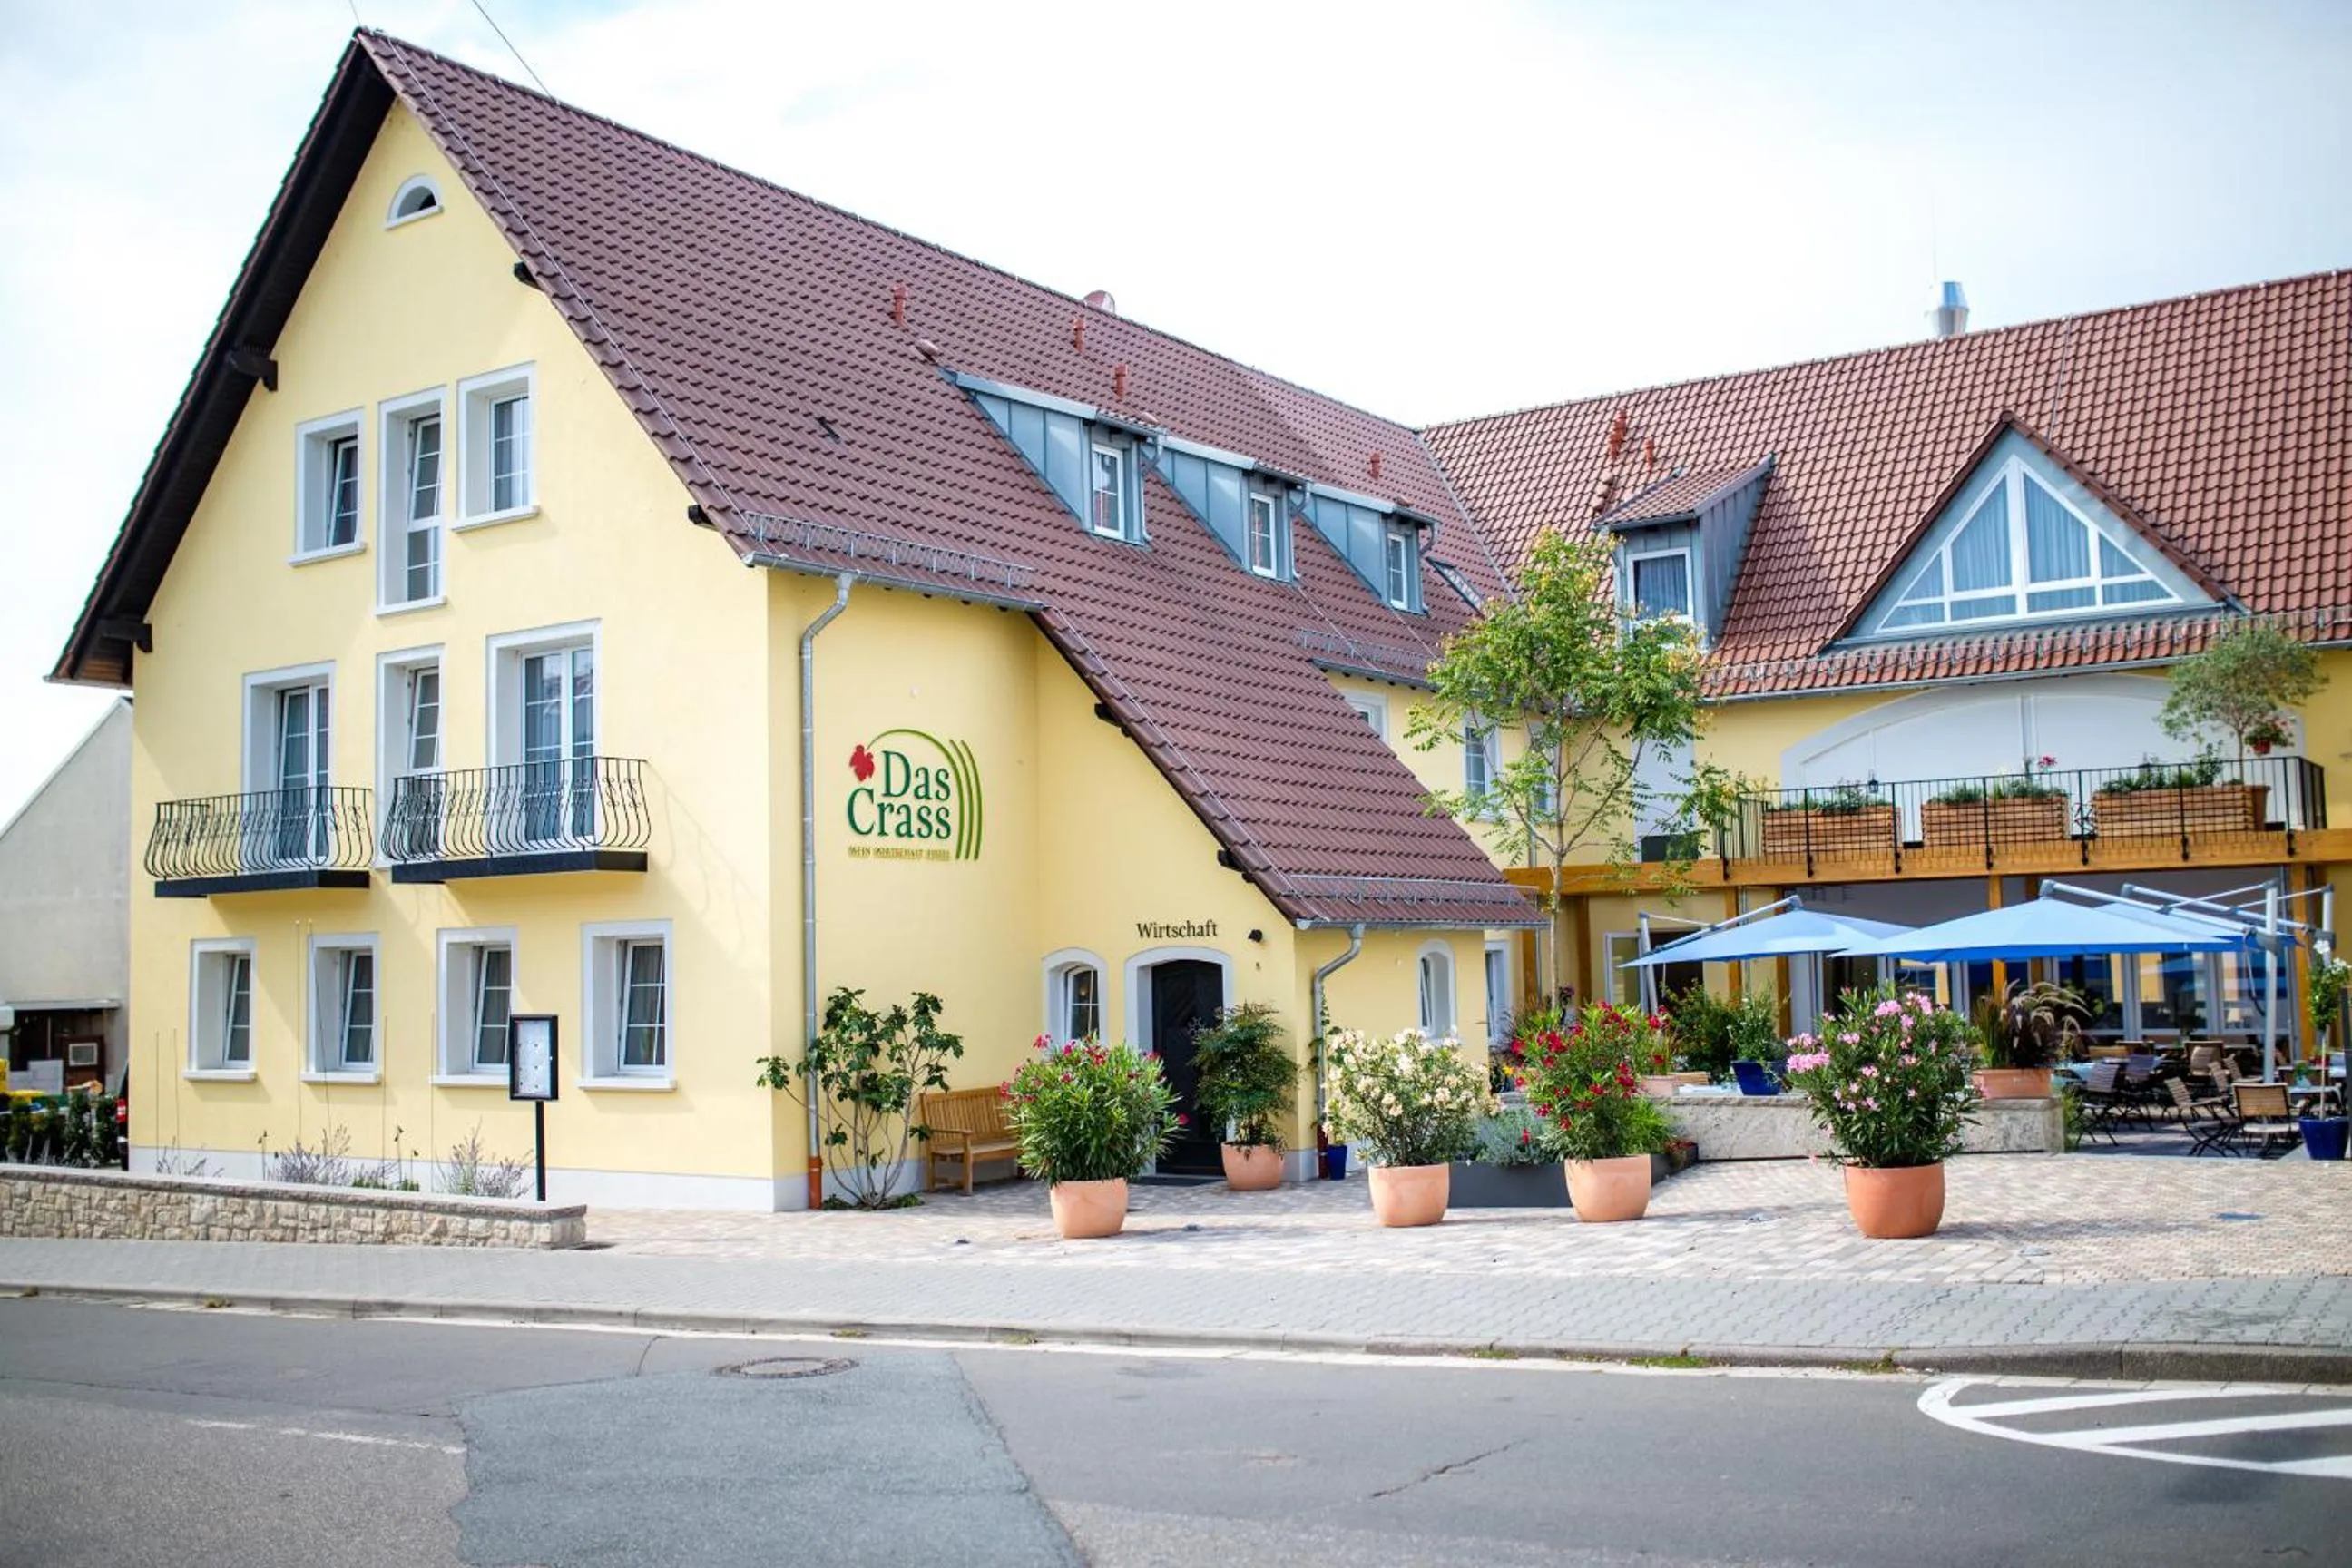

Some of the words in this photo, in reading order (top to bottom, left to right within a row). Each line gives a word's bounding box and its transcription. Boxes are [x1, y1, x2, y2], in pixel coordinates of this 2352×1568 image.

[881, 750, 951, 801] Das
[847, 787, 952, 839] Crass
[1136, 918, 1218, 939] Wirtschaft
